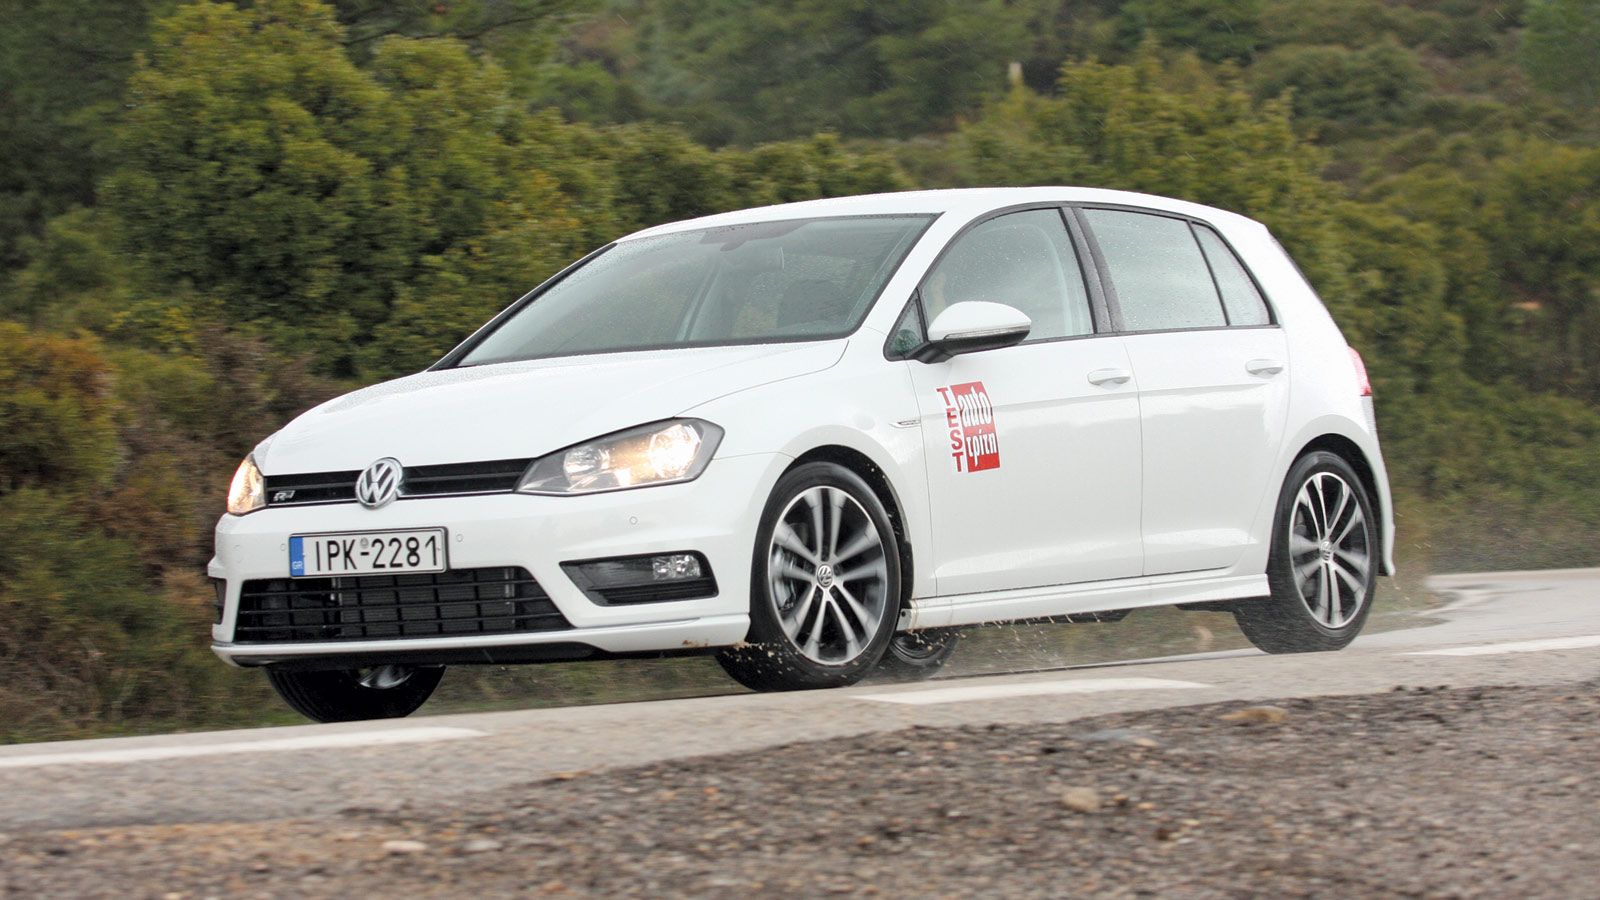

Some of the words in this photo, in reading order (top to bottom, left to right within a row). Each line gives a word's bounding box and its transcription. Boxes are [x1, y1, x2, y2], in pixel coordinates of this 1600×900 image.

[957, 386, 991, 426] auto
[937, 388, 964, 472] TEST
[292, 561, 303, 570] GR
